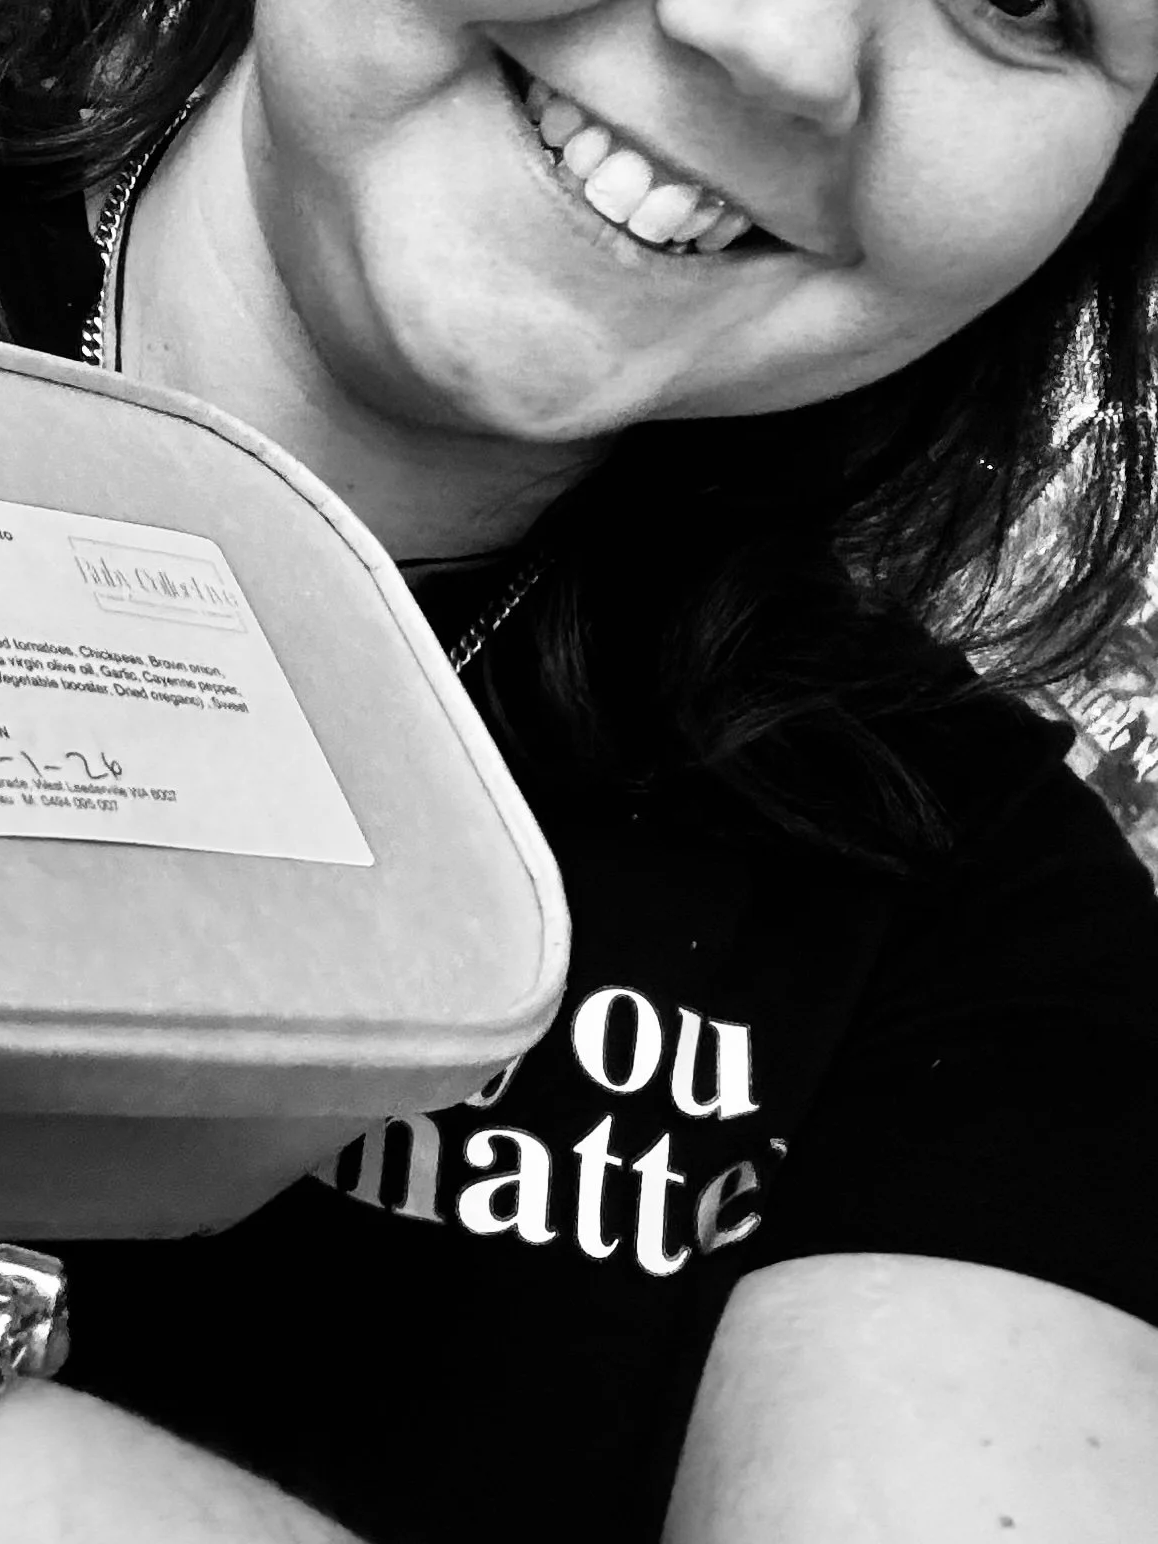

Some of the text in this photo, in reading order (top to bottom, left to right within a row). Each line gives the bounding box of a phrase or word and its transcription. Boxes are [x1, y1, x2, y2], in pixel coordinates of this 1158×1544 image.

[8, 656, 44, 672] virgin
[47, 659, 76, 674] olive
[142, 670, 196, 689] Cayenne
[148, 655, 188, 672] Brown
[113, 683, 149, 700] Dried
[464, 984, 760, 1119] ou
[308, 1112, 788, 1276] matte
